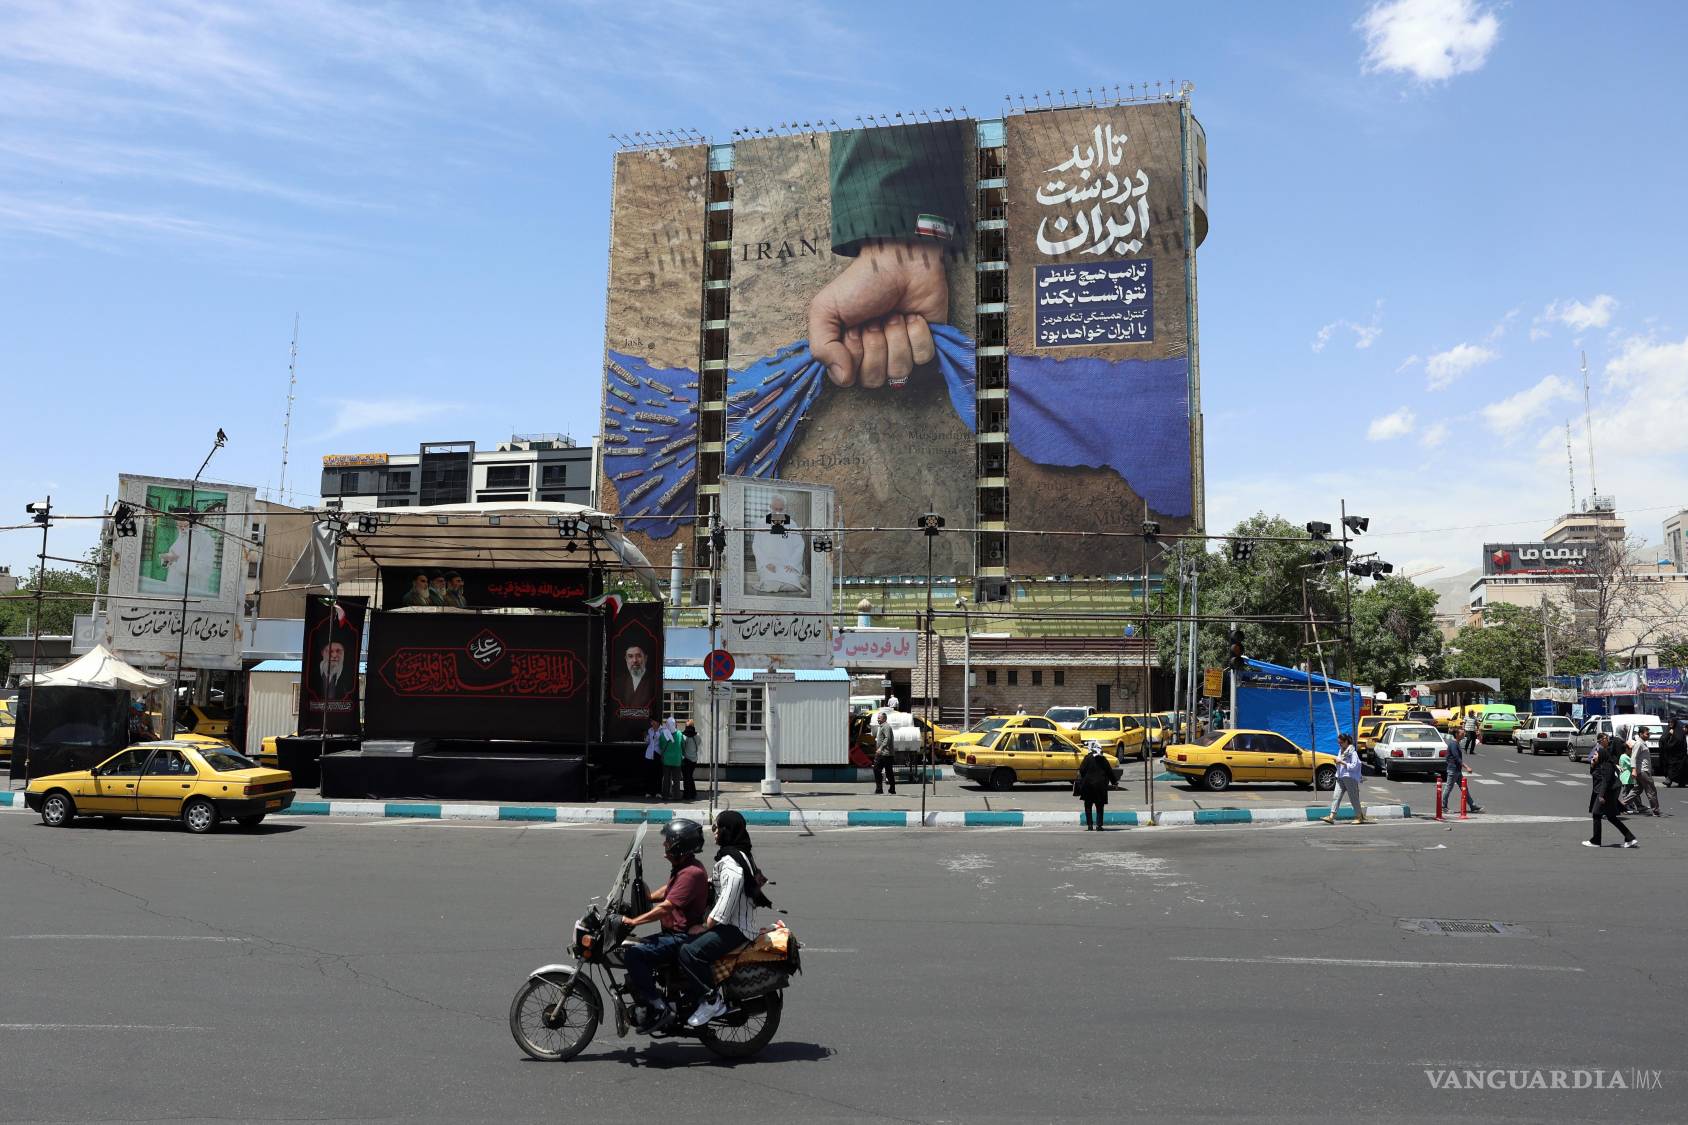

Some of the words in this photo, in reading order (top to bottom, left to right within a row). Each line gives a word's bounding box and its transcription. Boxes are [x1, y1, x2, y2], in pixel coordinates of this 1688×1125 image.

[1042, 124, 1104, 178] ابد
[1106, 124, 1128, 166] تا
[1036, 171, 1118, 206] دست
[1106, 169, 1150, 205] در
[1036, 195, 1150, 256] ایران
[741, 238, 818, 262] IRAN
[1039, 268, 1077, 287] غلطی
[1078, 269, 1106, 286] هیچ
[1108, 263, 1147, 286] ترامپ
[1040, 289, 1076, 307] بکند
[1077, 284, 1147, 304] نتوانست
[1042, 315, 1062, 326] هرمز
[1063, 313, 1083, 323] تنگه
[1083, 312, 1122, 324] همیشگی
[1123, 309, 1147, 322] کنترل
[1041, 329, 1060, 343] بود
[1061, 325, 1105, 340] خواهد
[1108, 324, 1134, 340] ایران
[1138, 324, 1147, 337] با
[623, 338, 644, 350] Jask
[1518, 547, 1539, 560] ما
[845, 636, 892, 658] فردیس
[893, 636, 910, 657] پل
